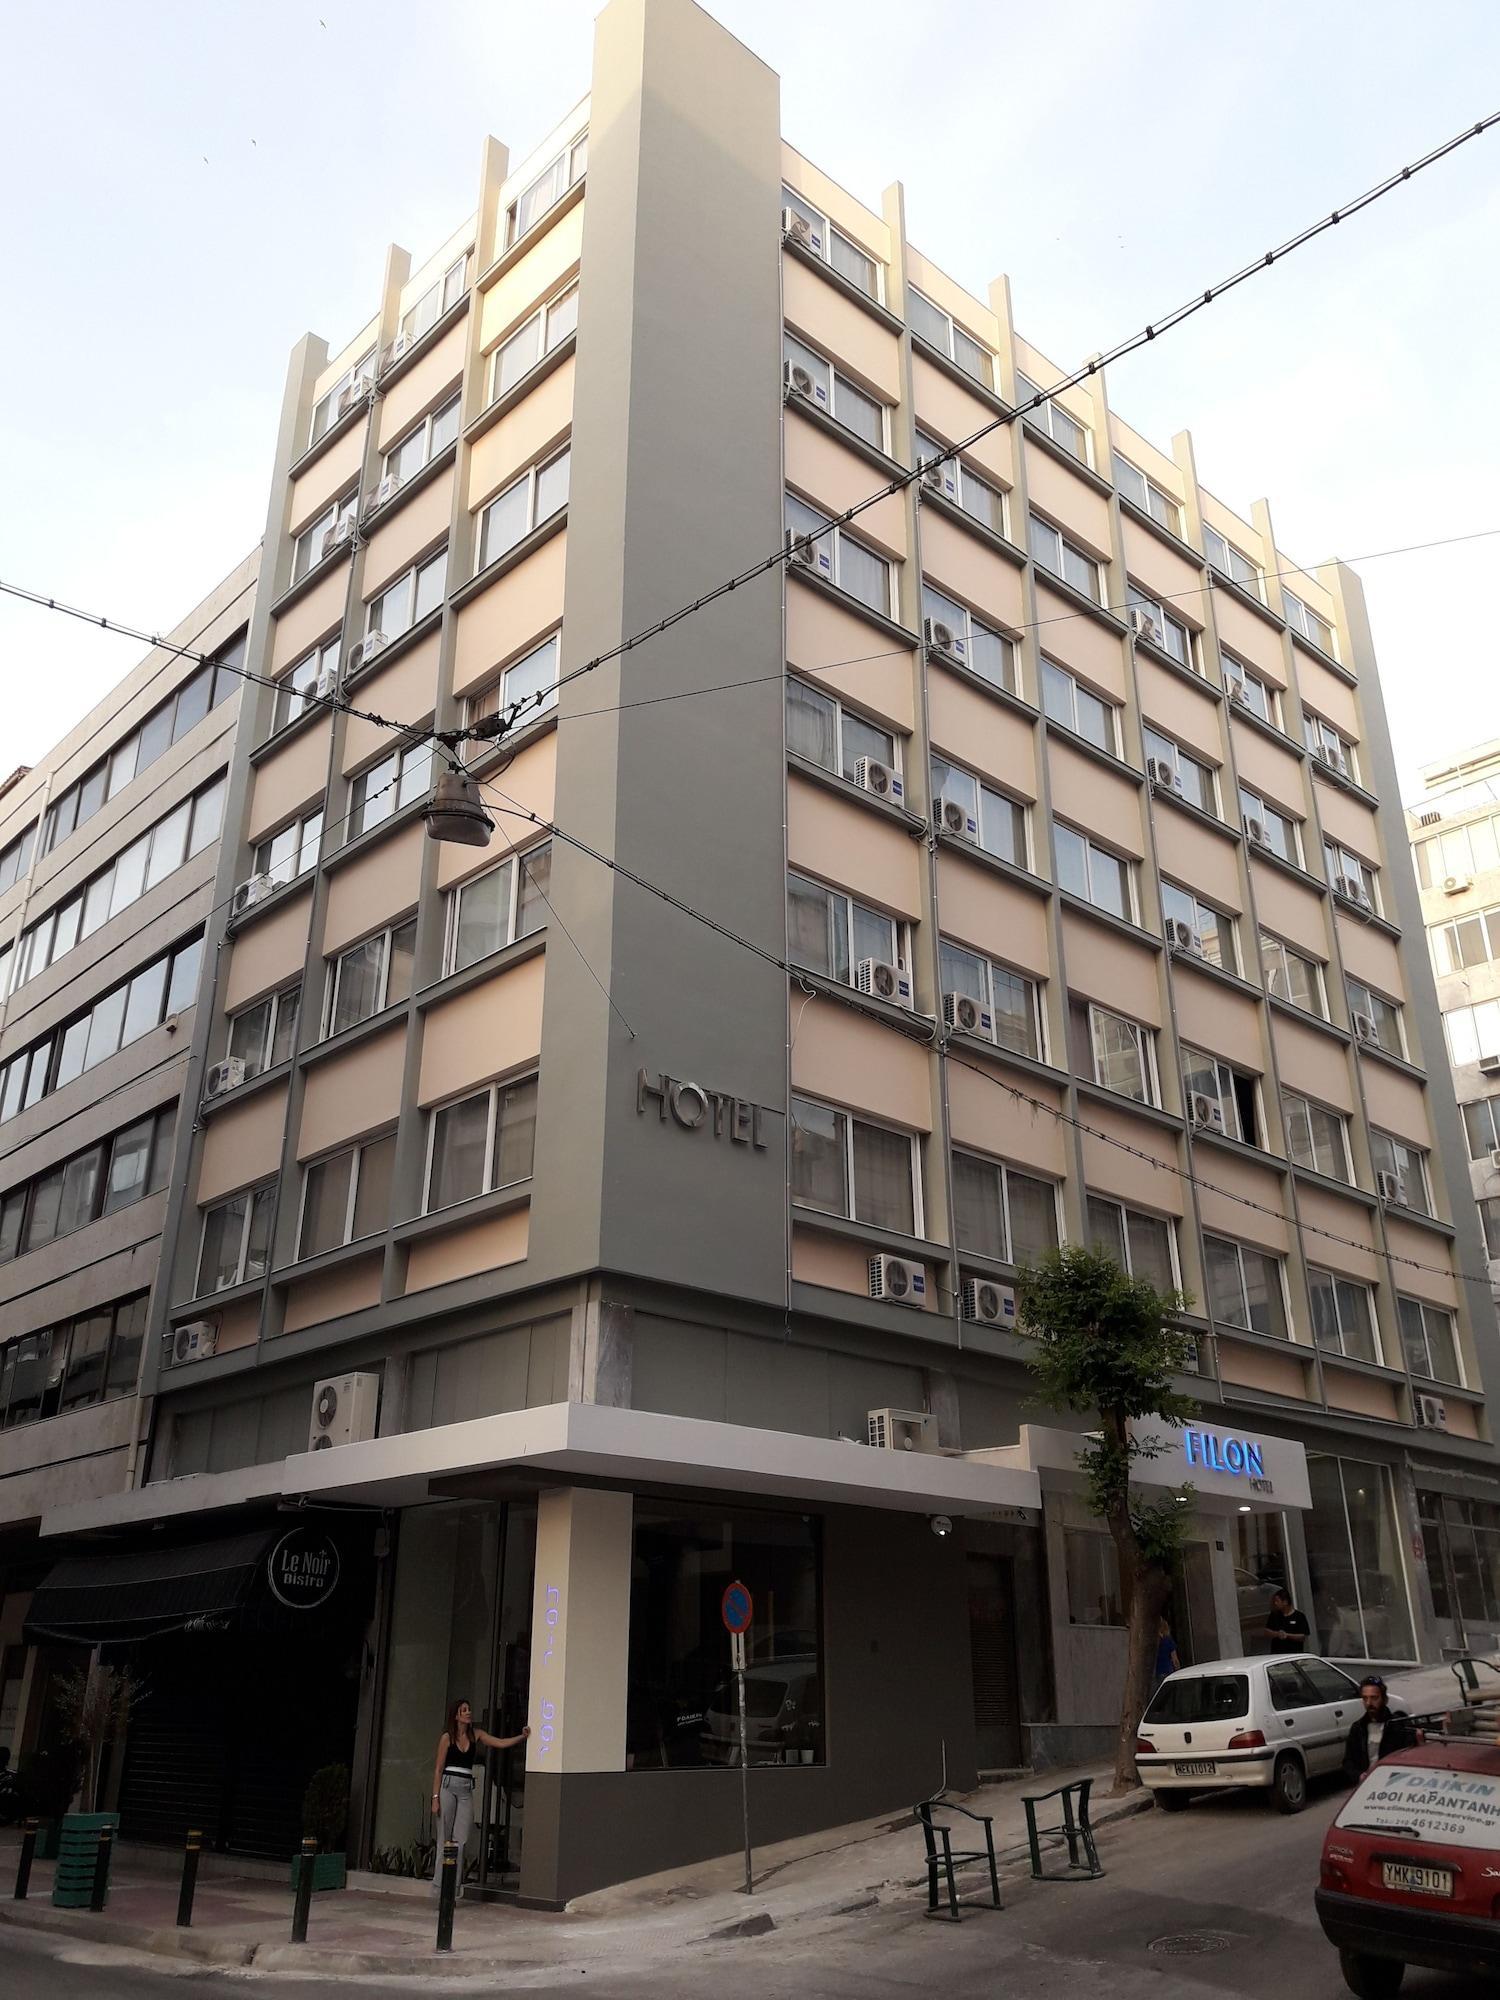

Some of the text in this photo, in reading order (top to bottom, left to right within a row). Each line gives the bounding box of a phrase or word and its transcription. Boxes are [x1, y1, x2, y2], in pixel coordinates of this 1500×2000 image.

[637, 1067, 768, 1149] HOTEL
[1185, 1430, 1264, 1476] FILON
[1248, 1478, 1274, 1494] HOTEL
[281, 1550, 331, 1575] Le Noir
[283, 1573, 324, 1588] Bistro
[1406, 1776, 1496, 1797] DAIKIN
[1367, 1791, 1403, 1802] ΑΦΟΙ
[1411, 1817, 1466, 1835] 4612369
